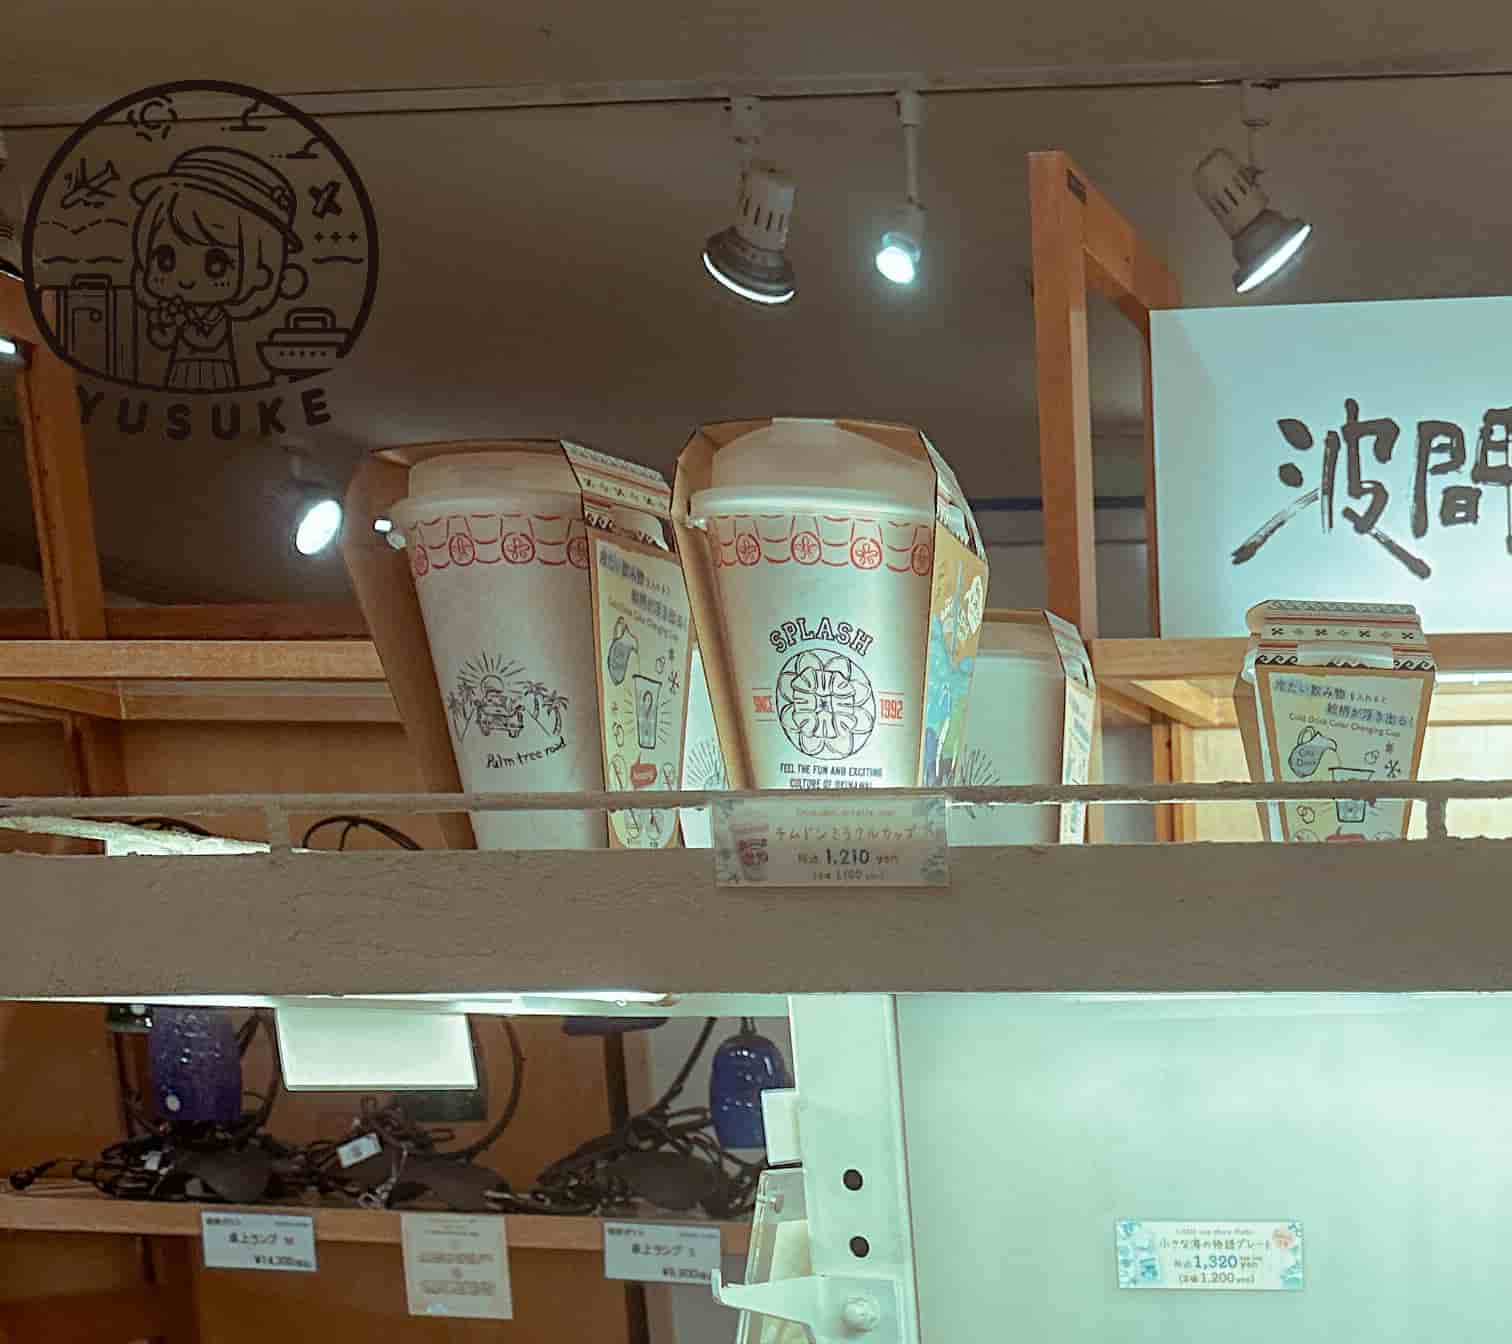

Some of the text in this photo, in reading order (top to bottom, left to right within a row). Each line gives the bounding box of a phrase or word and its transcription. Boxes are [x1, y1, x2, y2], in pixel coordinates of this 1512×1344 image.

[769, 616, 874, 656] SPLASH
[880, 698, 904, 720] 1992
[486, 753, 515, 769] Palm
[516, 751, 543, 766] tree
[812, 766, 828, 776] FUN
[830, 767, 847, 778] AND
[1193, 1254, 1238, 1271] 1,320
